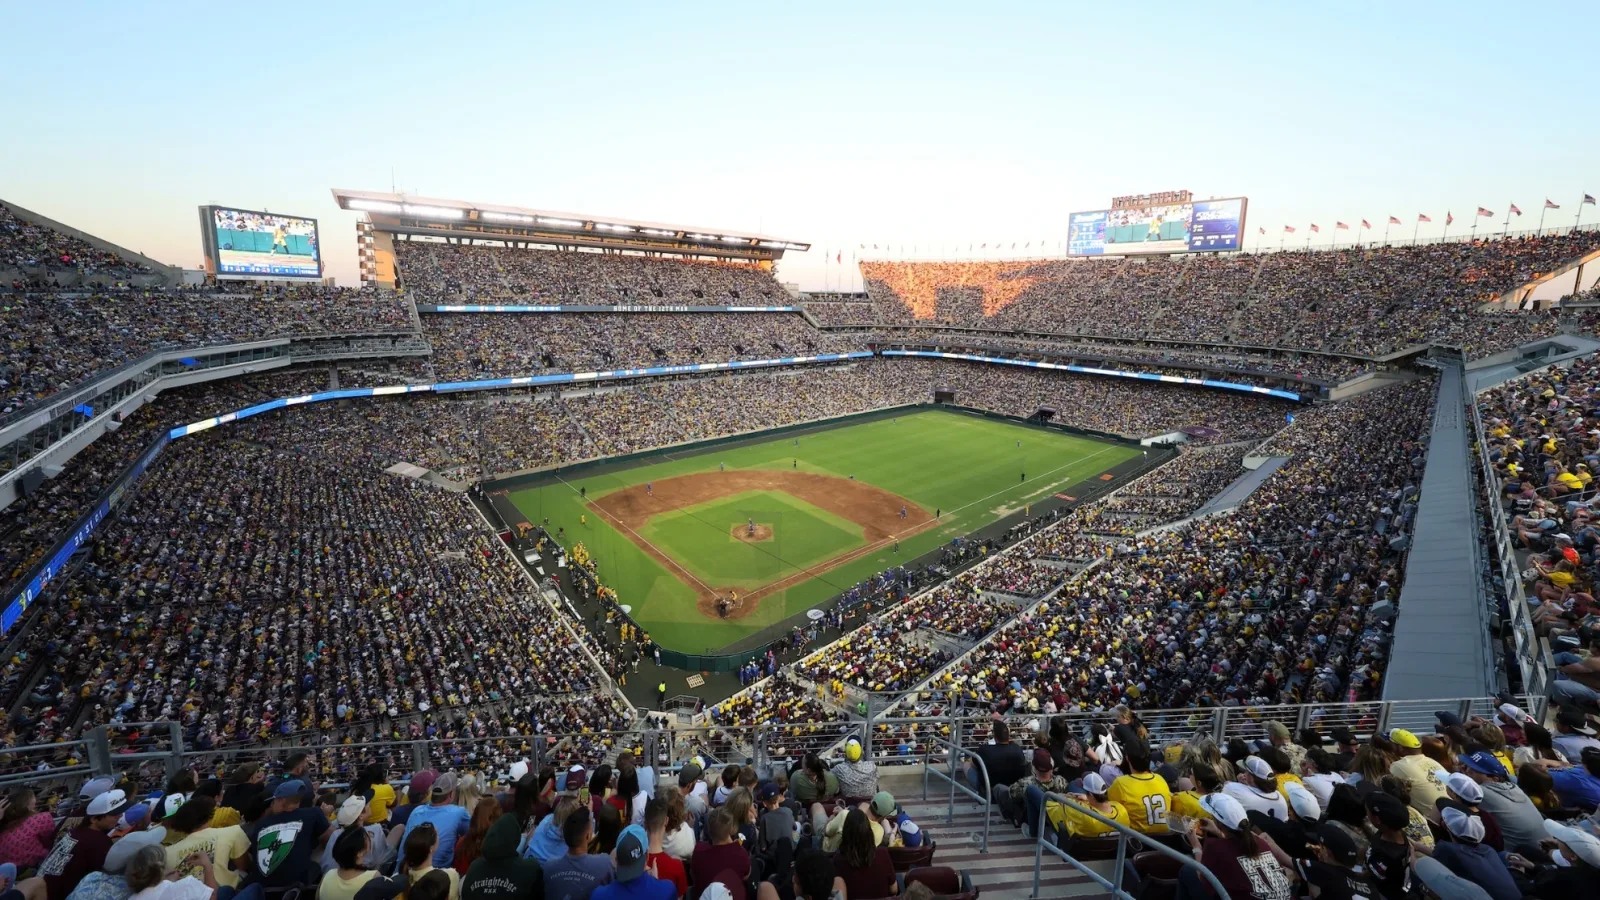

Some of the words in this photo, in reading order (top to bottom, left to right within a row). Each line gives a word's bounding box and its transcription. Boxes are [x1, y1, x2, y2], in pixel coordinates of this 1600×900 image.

[1112, 195, 1144, 209] KYLE
[1149, 190, 1188, 205] FIELD
[27, 589, 32, 601] 0
[1142, 793, 1167, 826] 12
[470, 876, 517, 893] straightedge
